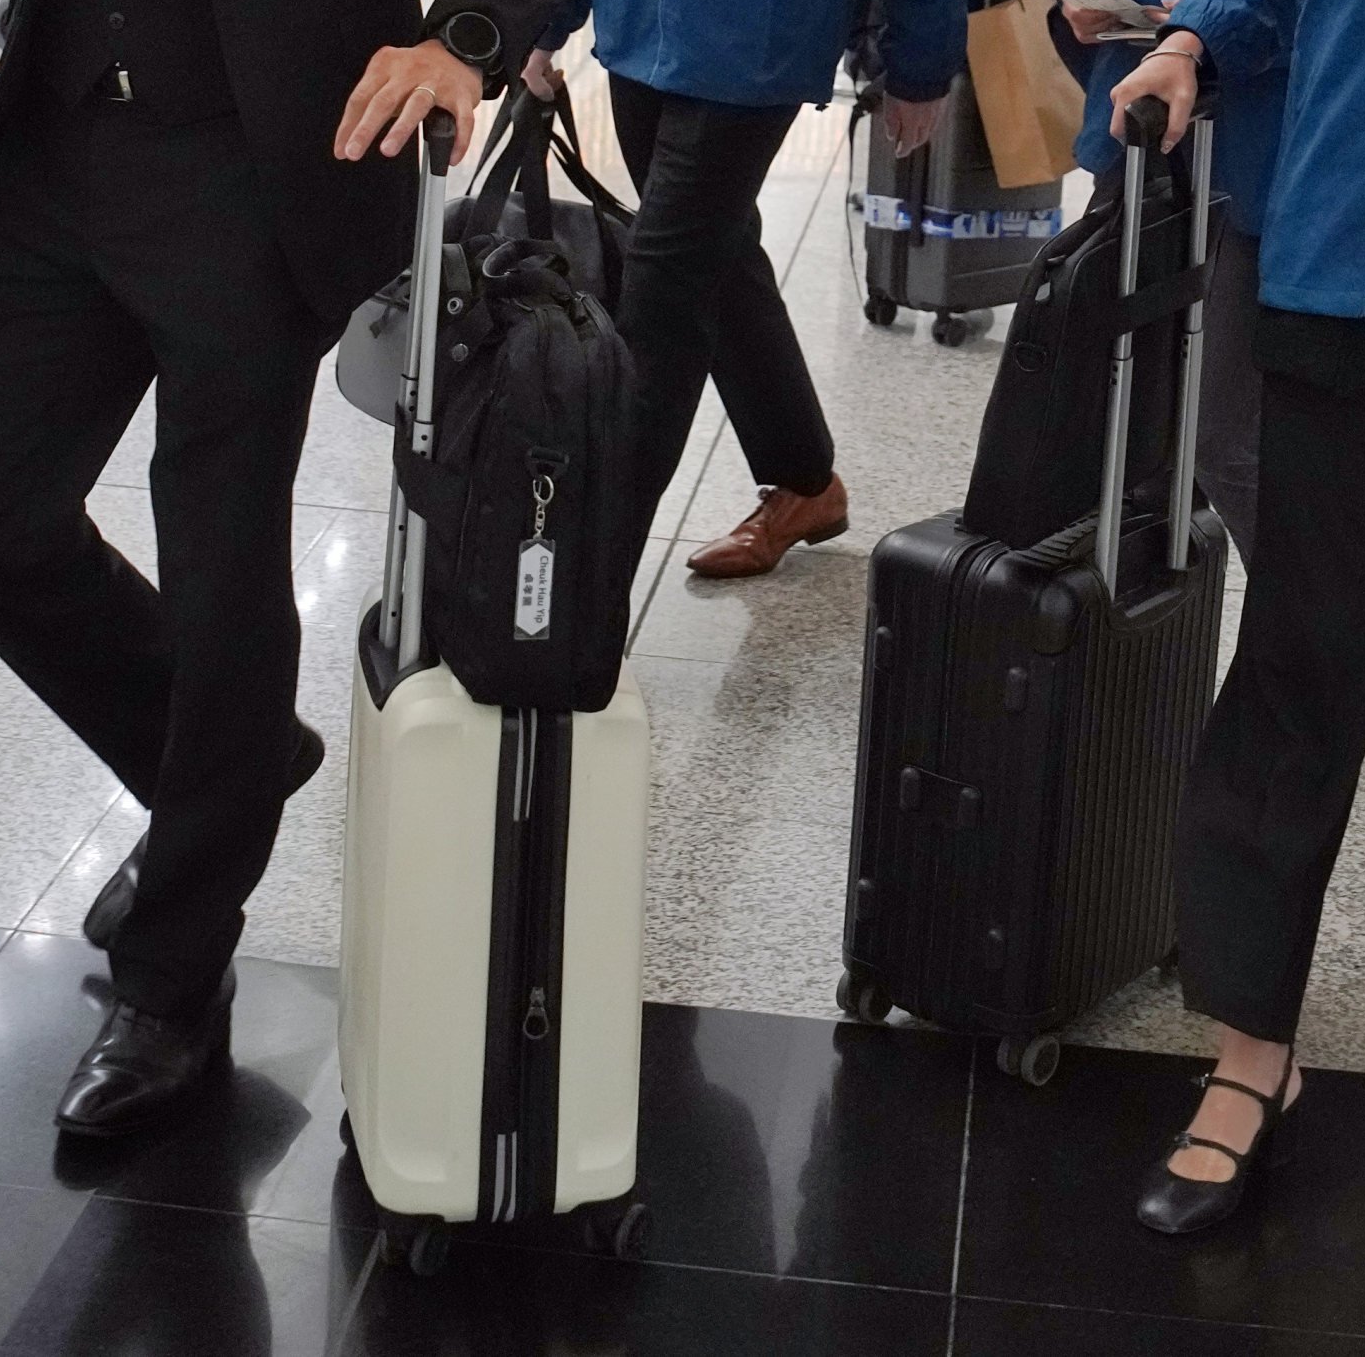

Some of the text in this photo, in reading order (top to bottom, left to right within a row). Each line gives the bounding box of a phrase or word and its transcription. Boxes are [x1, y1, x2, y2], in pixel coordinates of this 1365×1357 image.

[534, 555, 549, 624] Cheuk Hau Yip
